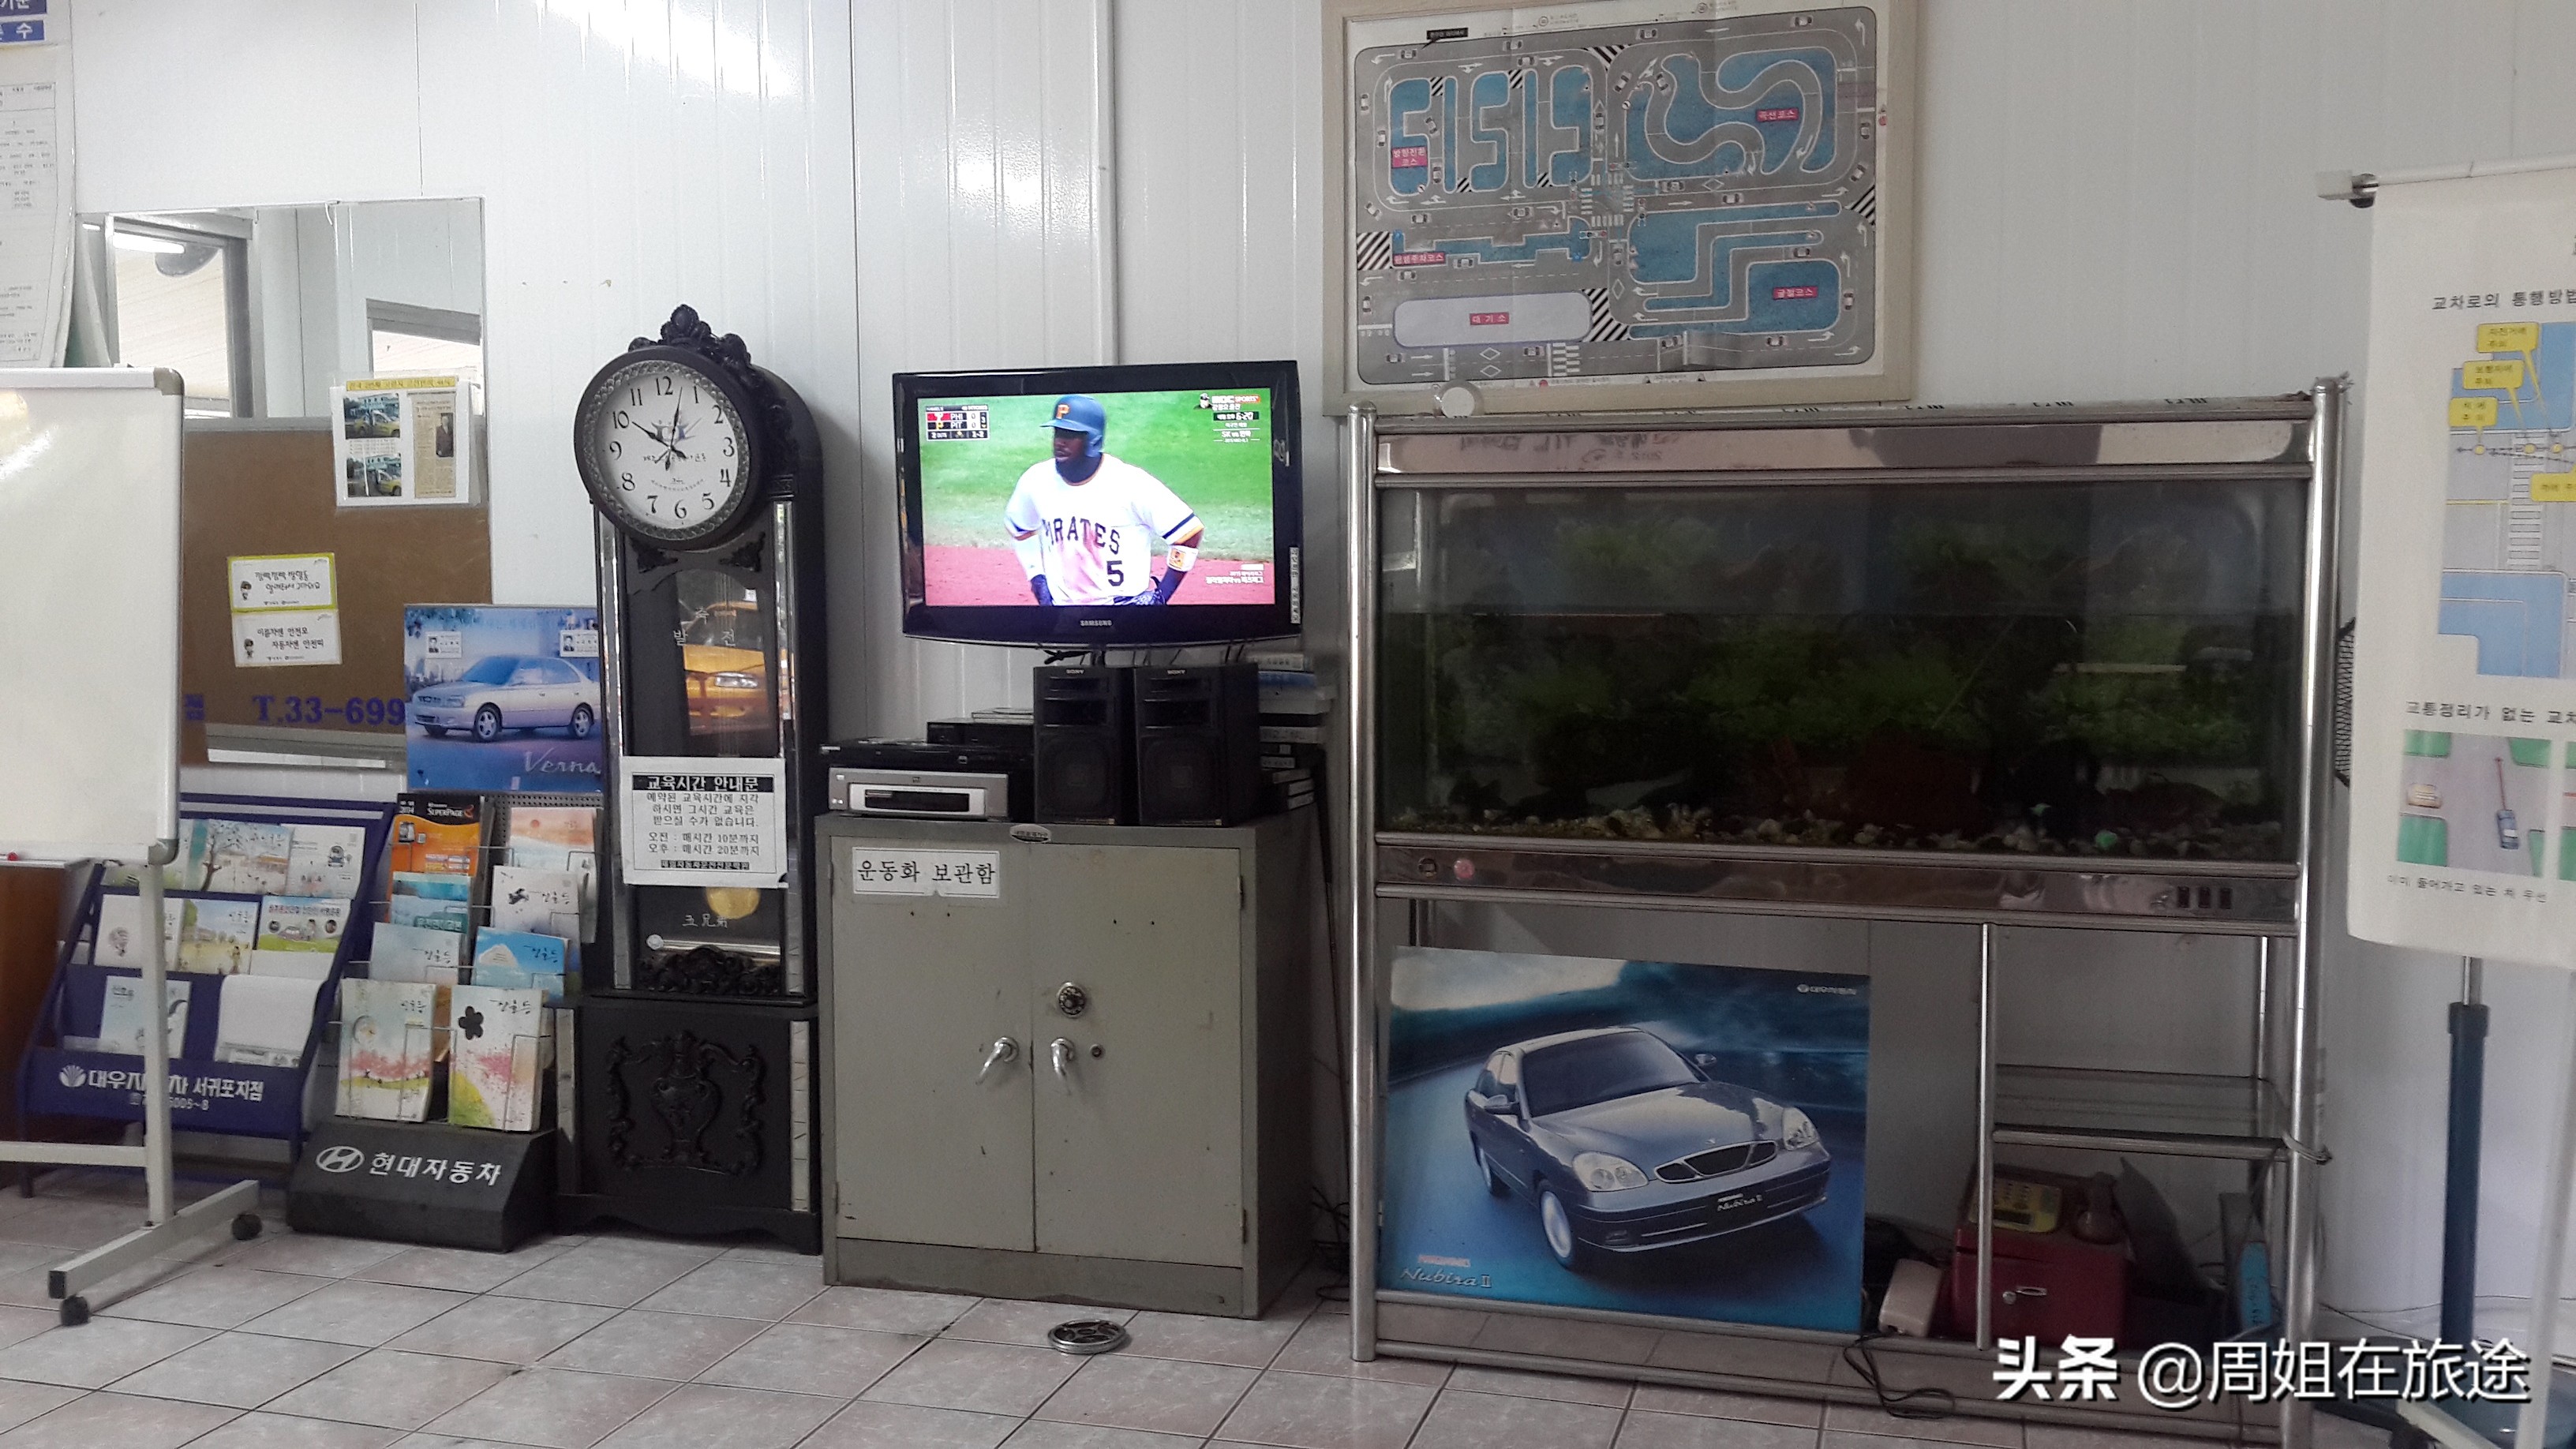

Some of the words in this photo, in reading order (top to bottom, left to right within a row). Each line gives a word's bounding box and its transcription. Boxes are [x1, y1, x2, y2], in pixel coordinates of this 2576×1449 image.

[2432, 292, 2500, 310] 교차로의
[655, 376, 673, 395] 12
[695, 385, 699, 404] 1
[630, 388, 643, 406] 11
[612, 410, 630, 429] 10
[712, 405, 724, 424] 2
[609, 440, 622, 460] 9
[723, 436, 735, 457] 3
[622, 473, 635, 491] 8
[720, 468, 732, 488] 4
[647, 495, 658, 514] 7
[675, 499, 687, 519] 6
[702, 492, 715, 510] 5
[1106, 560, 1124, 586] 5
[2406, 700, 2490, 721] 교통정리가
[524, 747, 602, 775] Verna
[646, 775, 706, 791] 교육시간
[713, 777, 758, 792] 안내문
[646, 792, 676, 803] 예약된
[682, 792, 733, 803] 교육시간에
[739, 794, 758, 804] 지각
[652, 803, 682, 814] 하시면
[688, 804, 717, 814] 그시간
[723, 805, 754, 815] 교육은
[653, 815, 683, 826] 받으실
[690, 816, 709, 826] 수가
[649, 832, 668, 842] 오전
[682, 832, 713, 843] 매시간
[717, 833, 759, 844] 10분까지
[682, 844, 713, 855] 매시간
[717, 844, 760, 856] 20분까지
[857, 860, 920, 884] 운동화
[931, 862, 996, 886] 보관함
[193, 1076, 264, 1103] 서귀포지점
[369, 1151, 503, 1186] 현대자동차
[1400, 1267, 1477, 1286] Nubira
